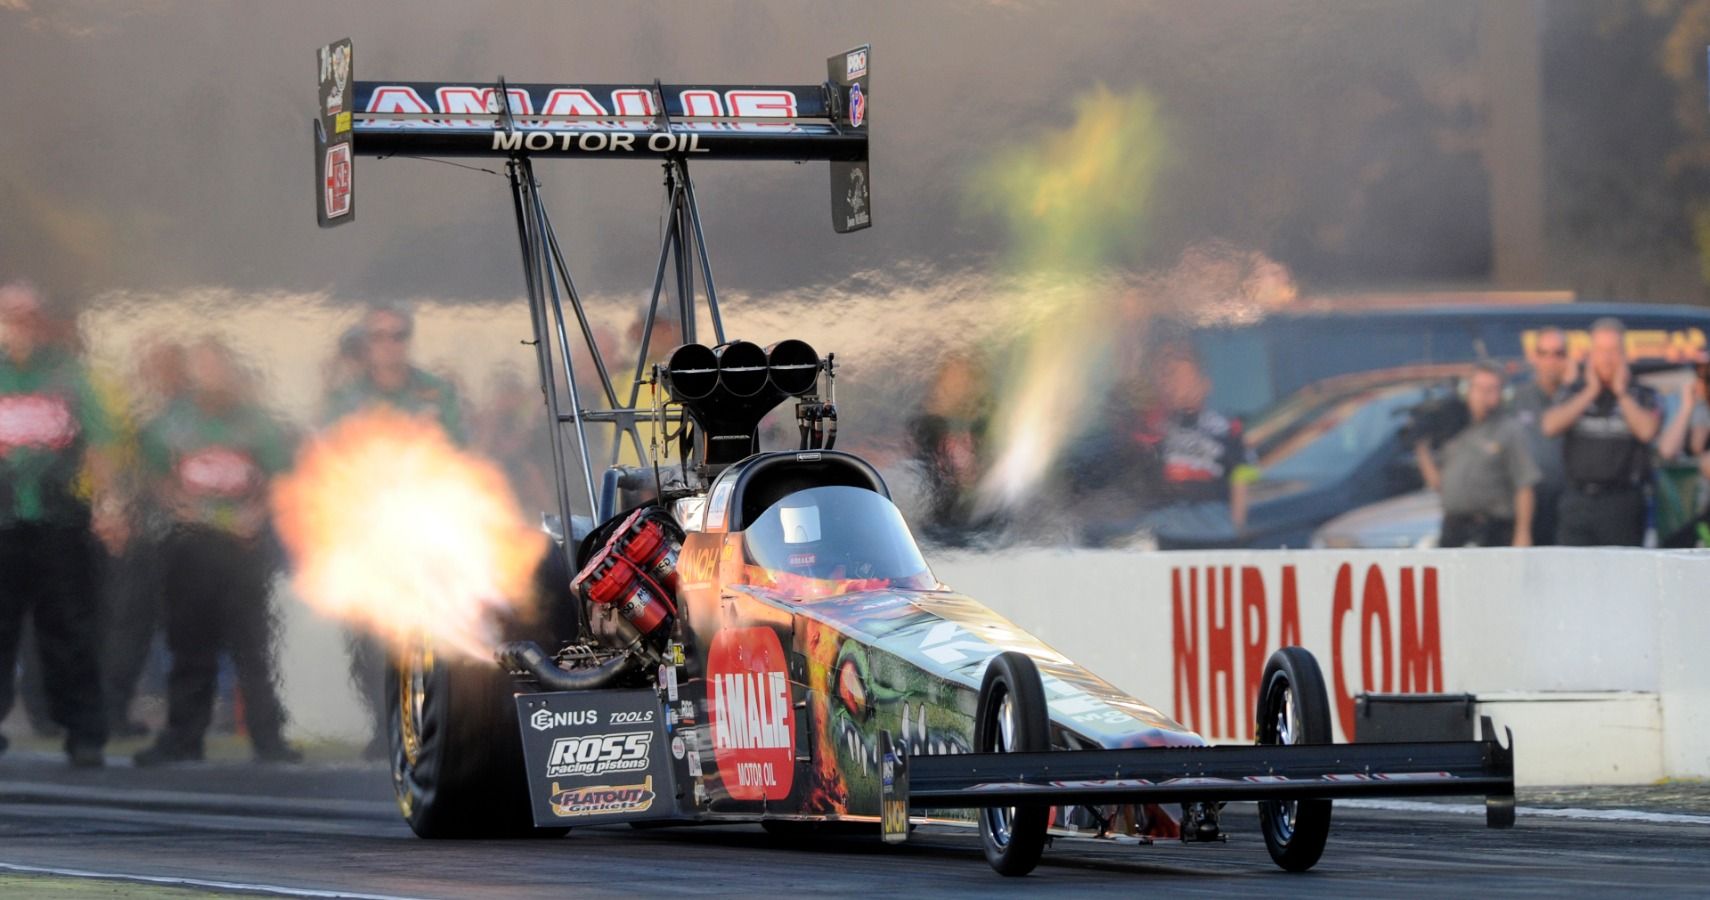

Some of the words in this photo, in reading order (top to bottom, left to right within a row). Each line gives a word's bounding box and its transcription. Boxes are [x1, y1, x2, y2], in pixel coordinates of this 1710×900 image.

[364, 86, 799, 126] AMALIE
[491, 131, 635, 152] MOTOR
[647, 132, 711, 153] OIL
[609, 710, 654, 724] TOOLS
[715, 671, 791, 749] AMALIE
[550, 734, 650, 766] ROSS
[550, 762, 595, 775] racing
[596, 758, 647, 773] pistons
[737, 762, 763, 786] MOTOR
[763, 762, 777, 786] OIL
[560, 788, 644, 807] FLATOUT
[568, 802, 637, 813] Gaskets
